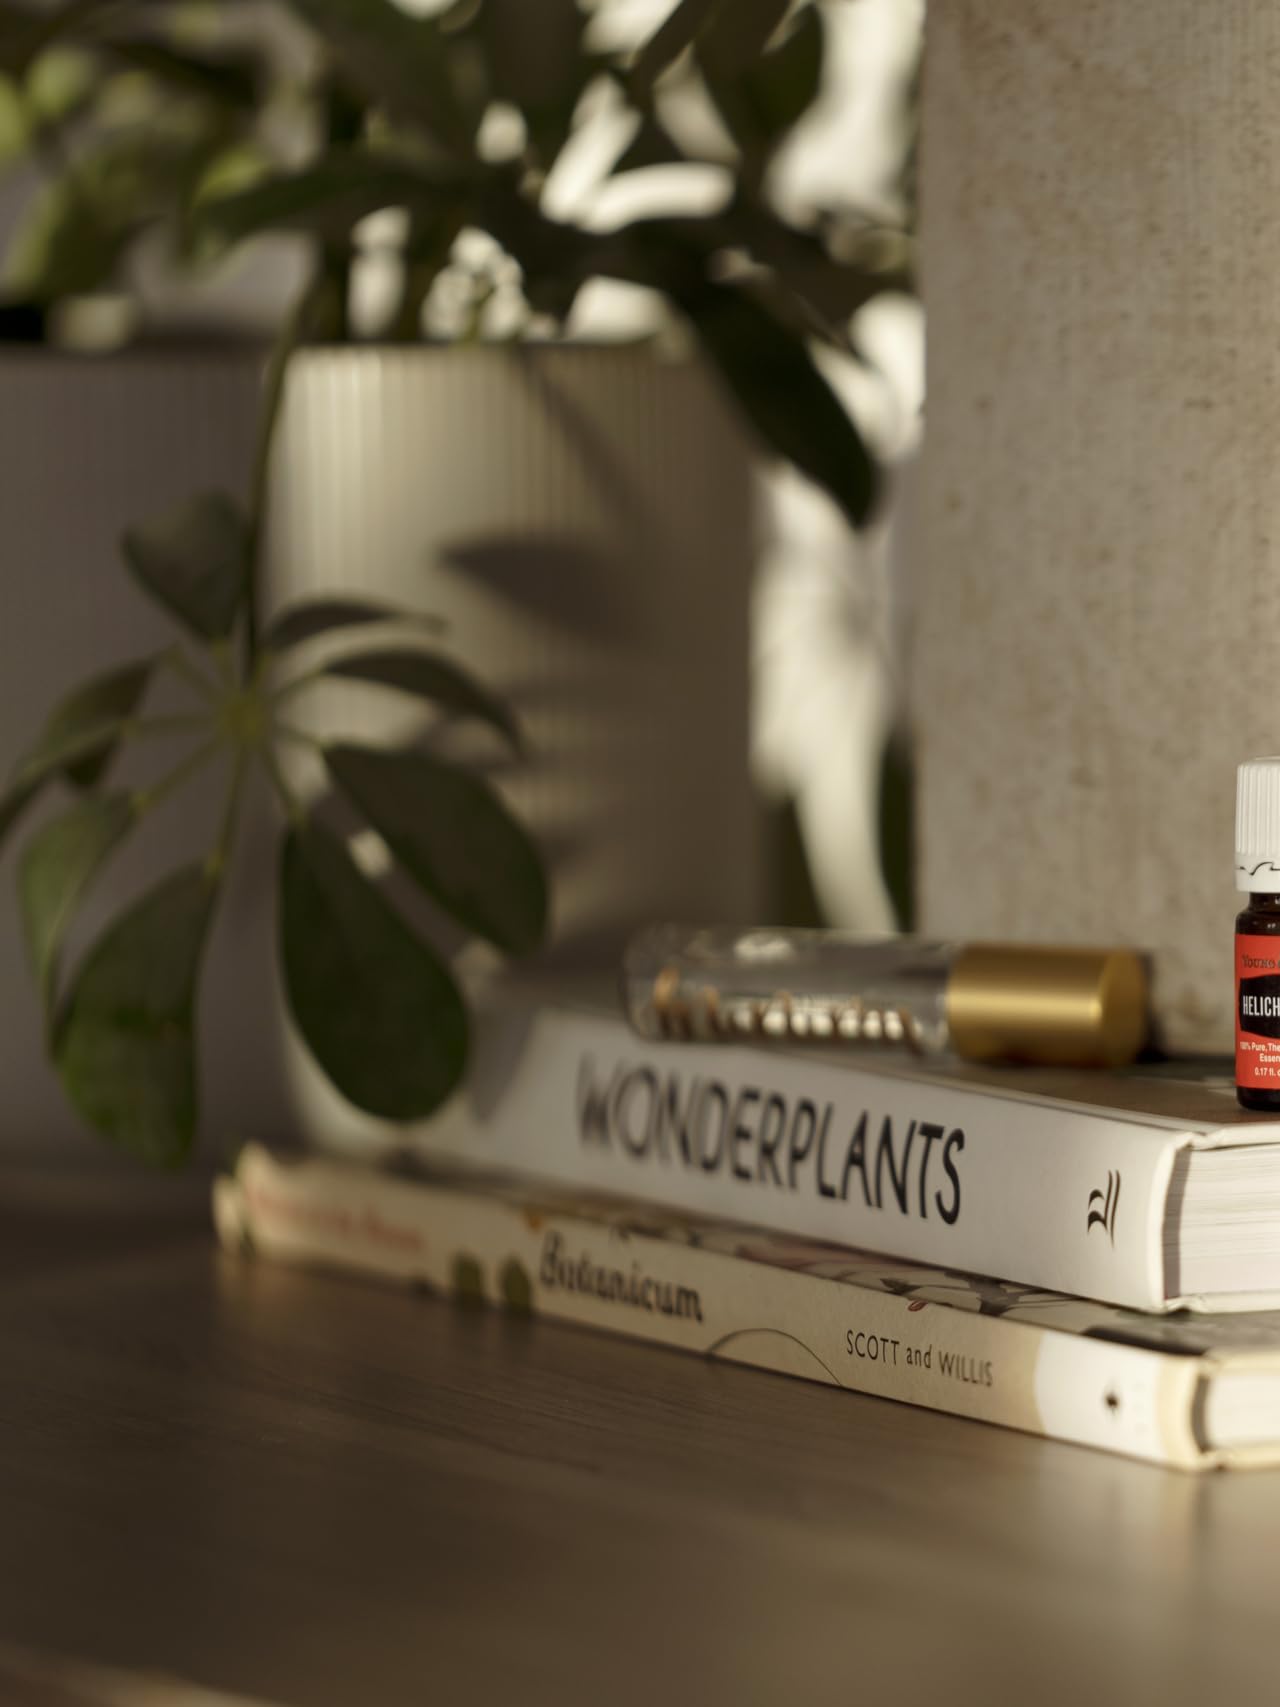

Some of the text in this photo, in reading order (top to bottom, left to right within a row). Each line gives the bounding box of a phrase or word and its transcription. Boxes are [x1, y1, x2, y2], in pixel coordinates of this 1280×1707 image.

[1242, 953, 1275, 968] YOUNG
[1254, 1067, 1267, 1076] 0.17
[575, 1050, 965, 1226] WONDERPLANTS
[539, 1230, 704, 1325] Botanicum
[846, 1328, 993, 1388] SCOTT and WILLIS
